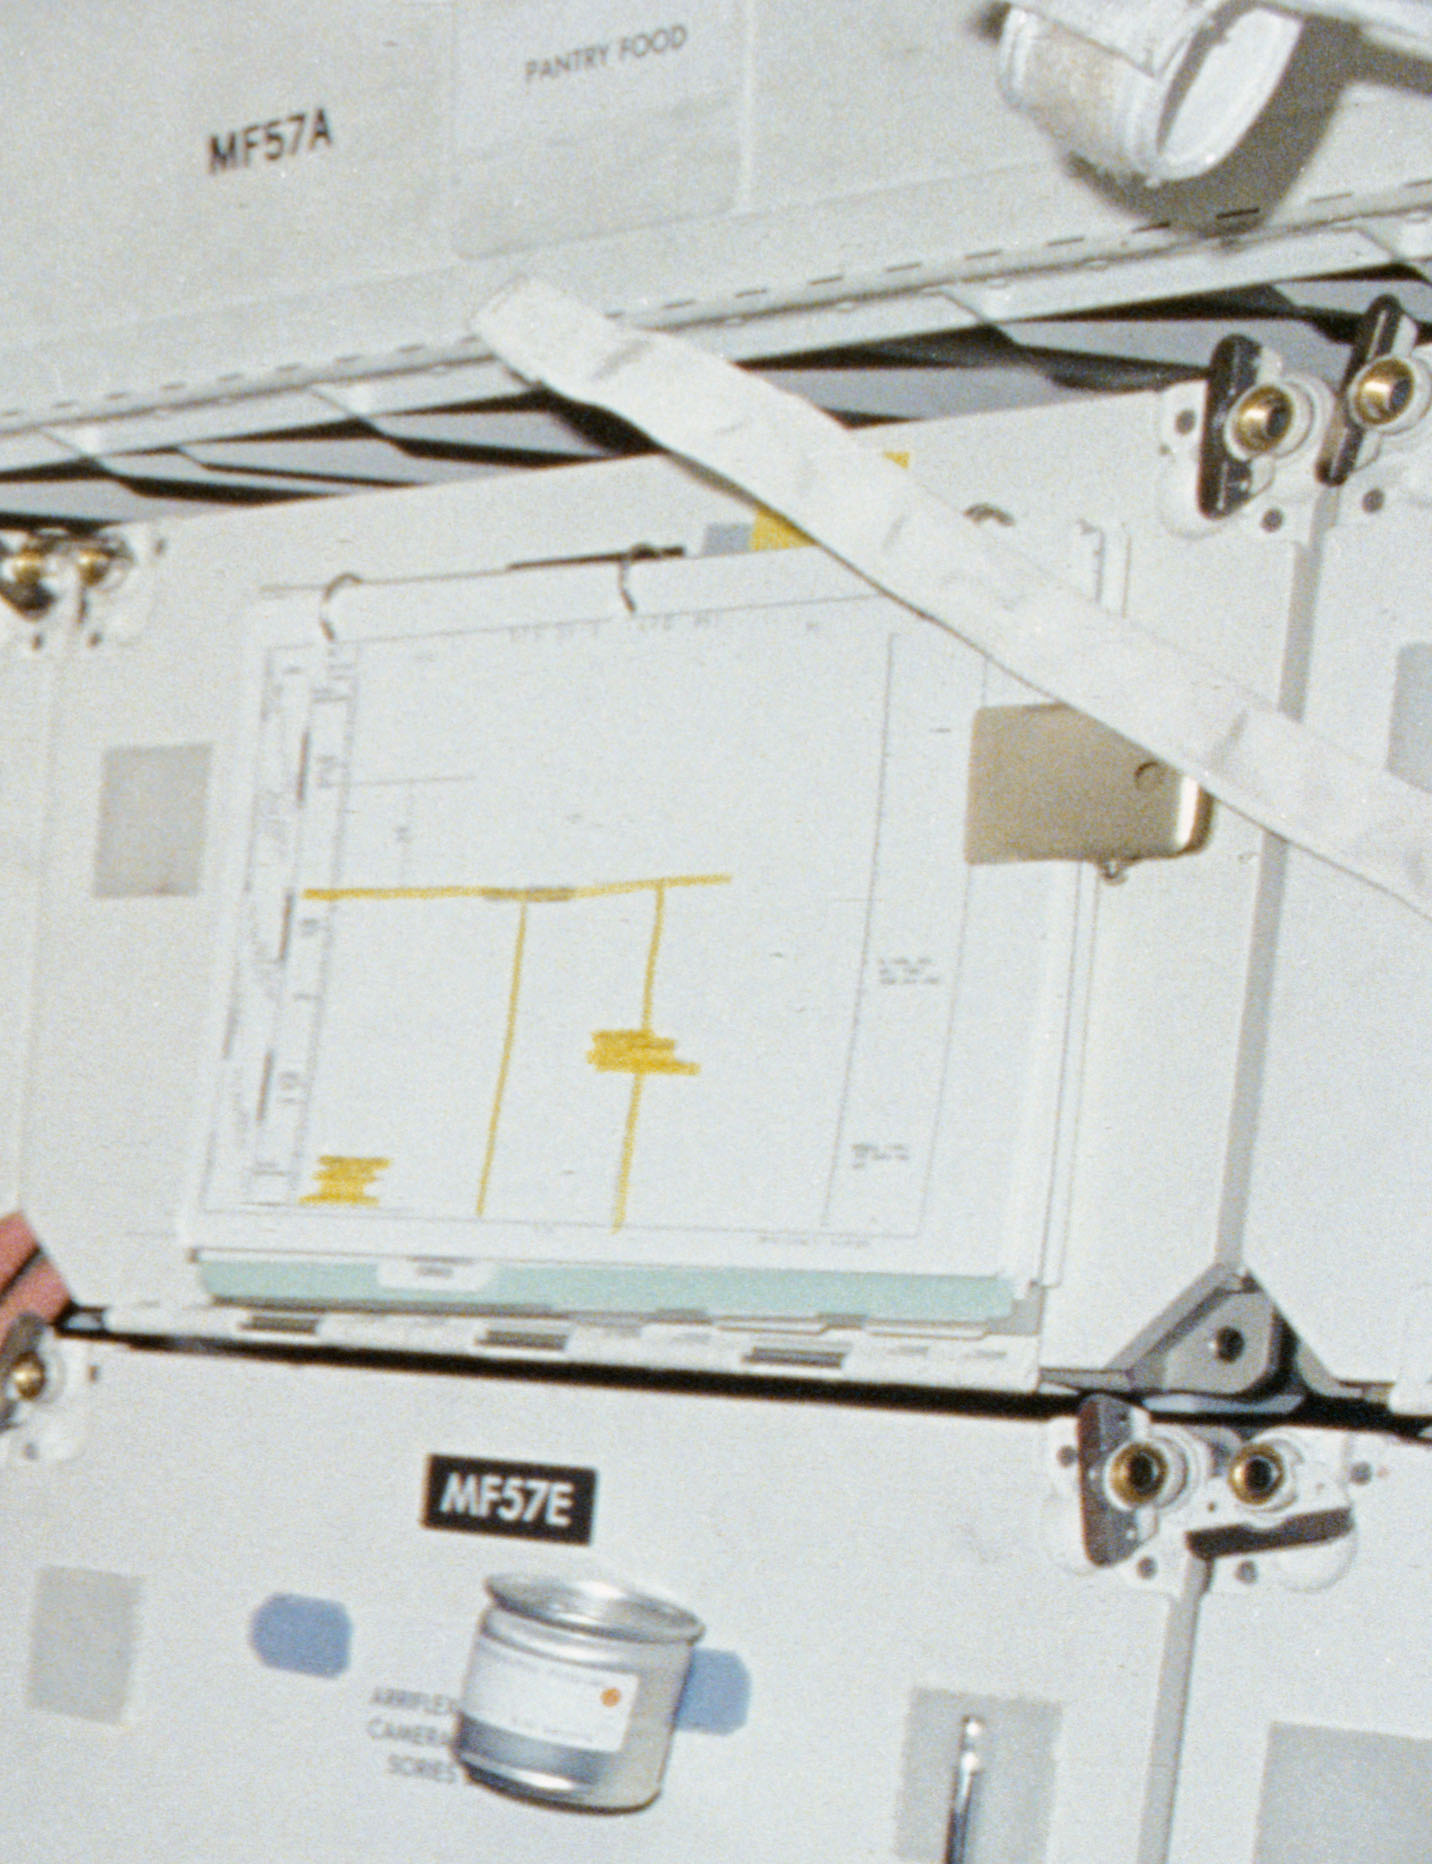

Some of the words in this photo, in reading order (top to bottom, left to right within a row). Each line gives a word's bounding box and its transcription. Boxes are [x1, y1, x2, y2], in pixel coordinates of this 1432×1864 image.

[618, 23, 688, 60] FOOD
[207, 107, 333, 176] MF57A
[438, 1471, 575, 1528] MF57E
